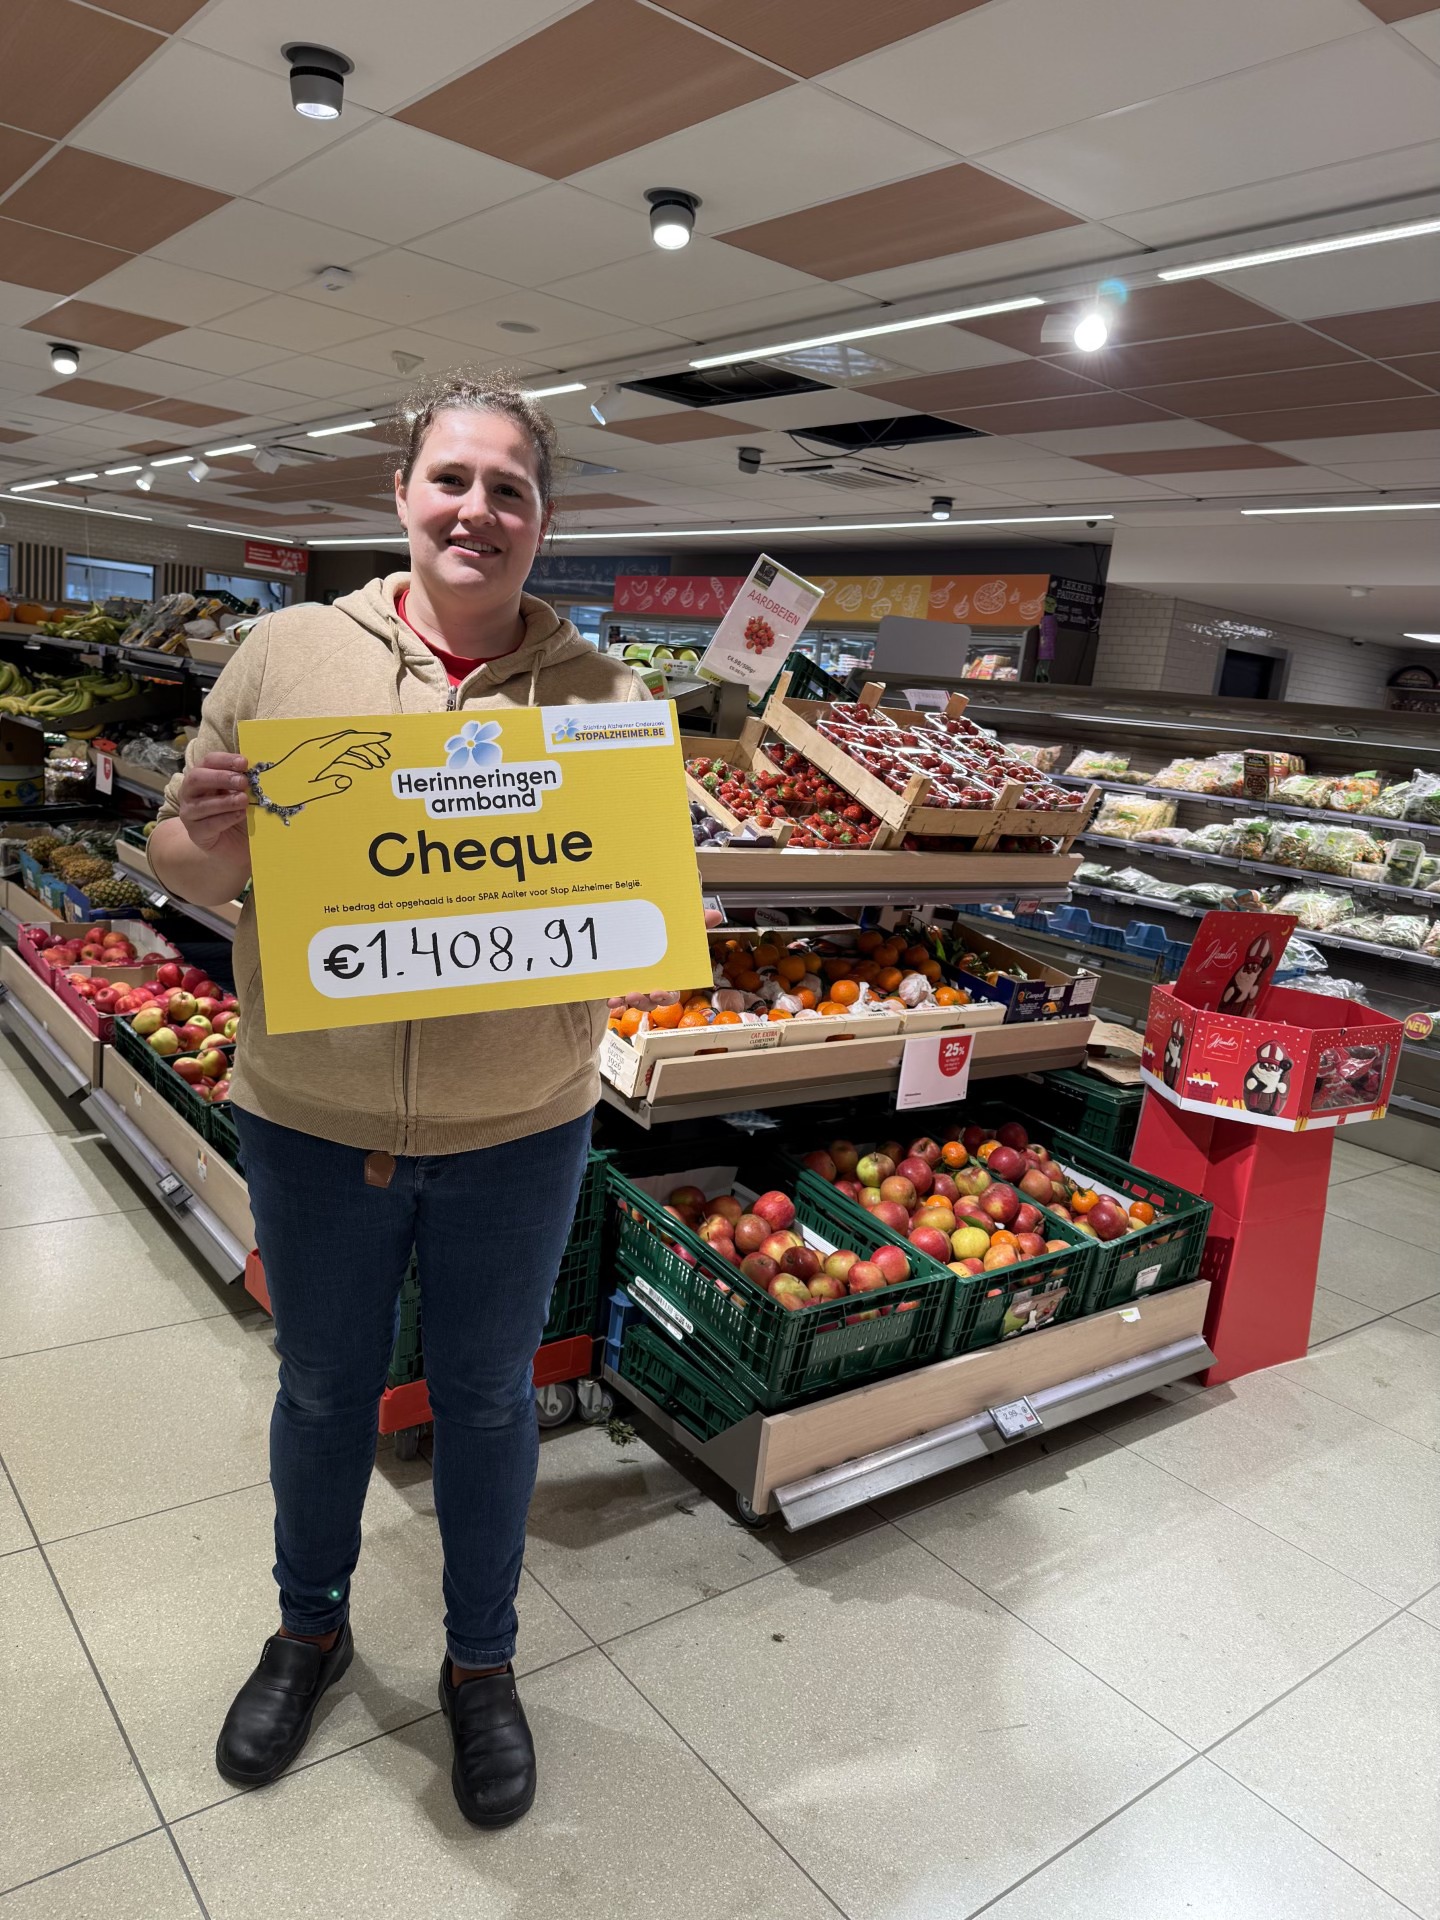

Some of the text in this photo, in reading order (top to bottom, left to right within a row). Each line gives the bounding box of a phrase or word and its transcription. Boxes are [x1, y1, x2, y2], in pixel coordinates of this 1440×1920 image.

[747, 589, 800, 625] AARDBEIEN
[575, 728, 665, 741] STOPALZHEIMER.BE
[397, 768, 557, 794] Herinneringen
[431, 789, 536, 813] armband
[368, 830, 593, 882] Cheque
[324, 879, 643, 914] Het bedrag dat opgehaald is door SPAR Aalter voor Stop Alzheimer België.
[762, 1030, 778, 1038] EXTRA
[1406, 1019, 1430, 1034] NEW
[943, 1042, 965, 1057] -25%
[608, 1055, 622, 1071] 1926
